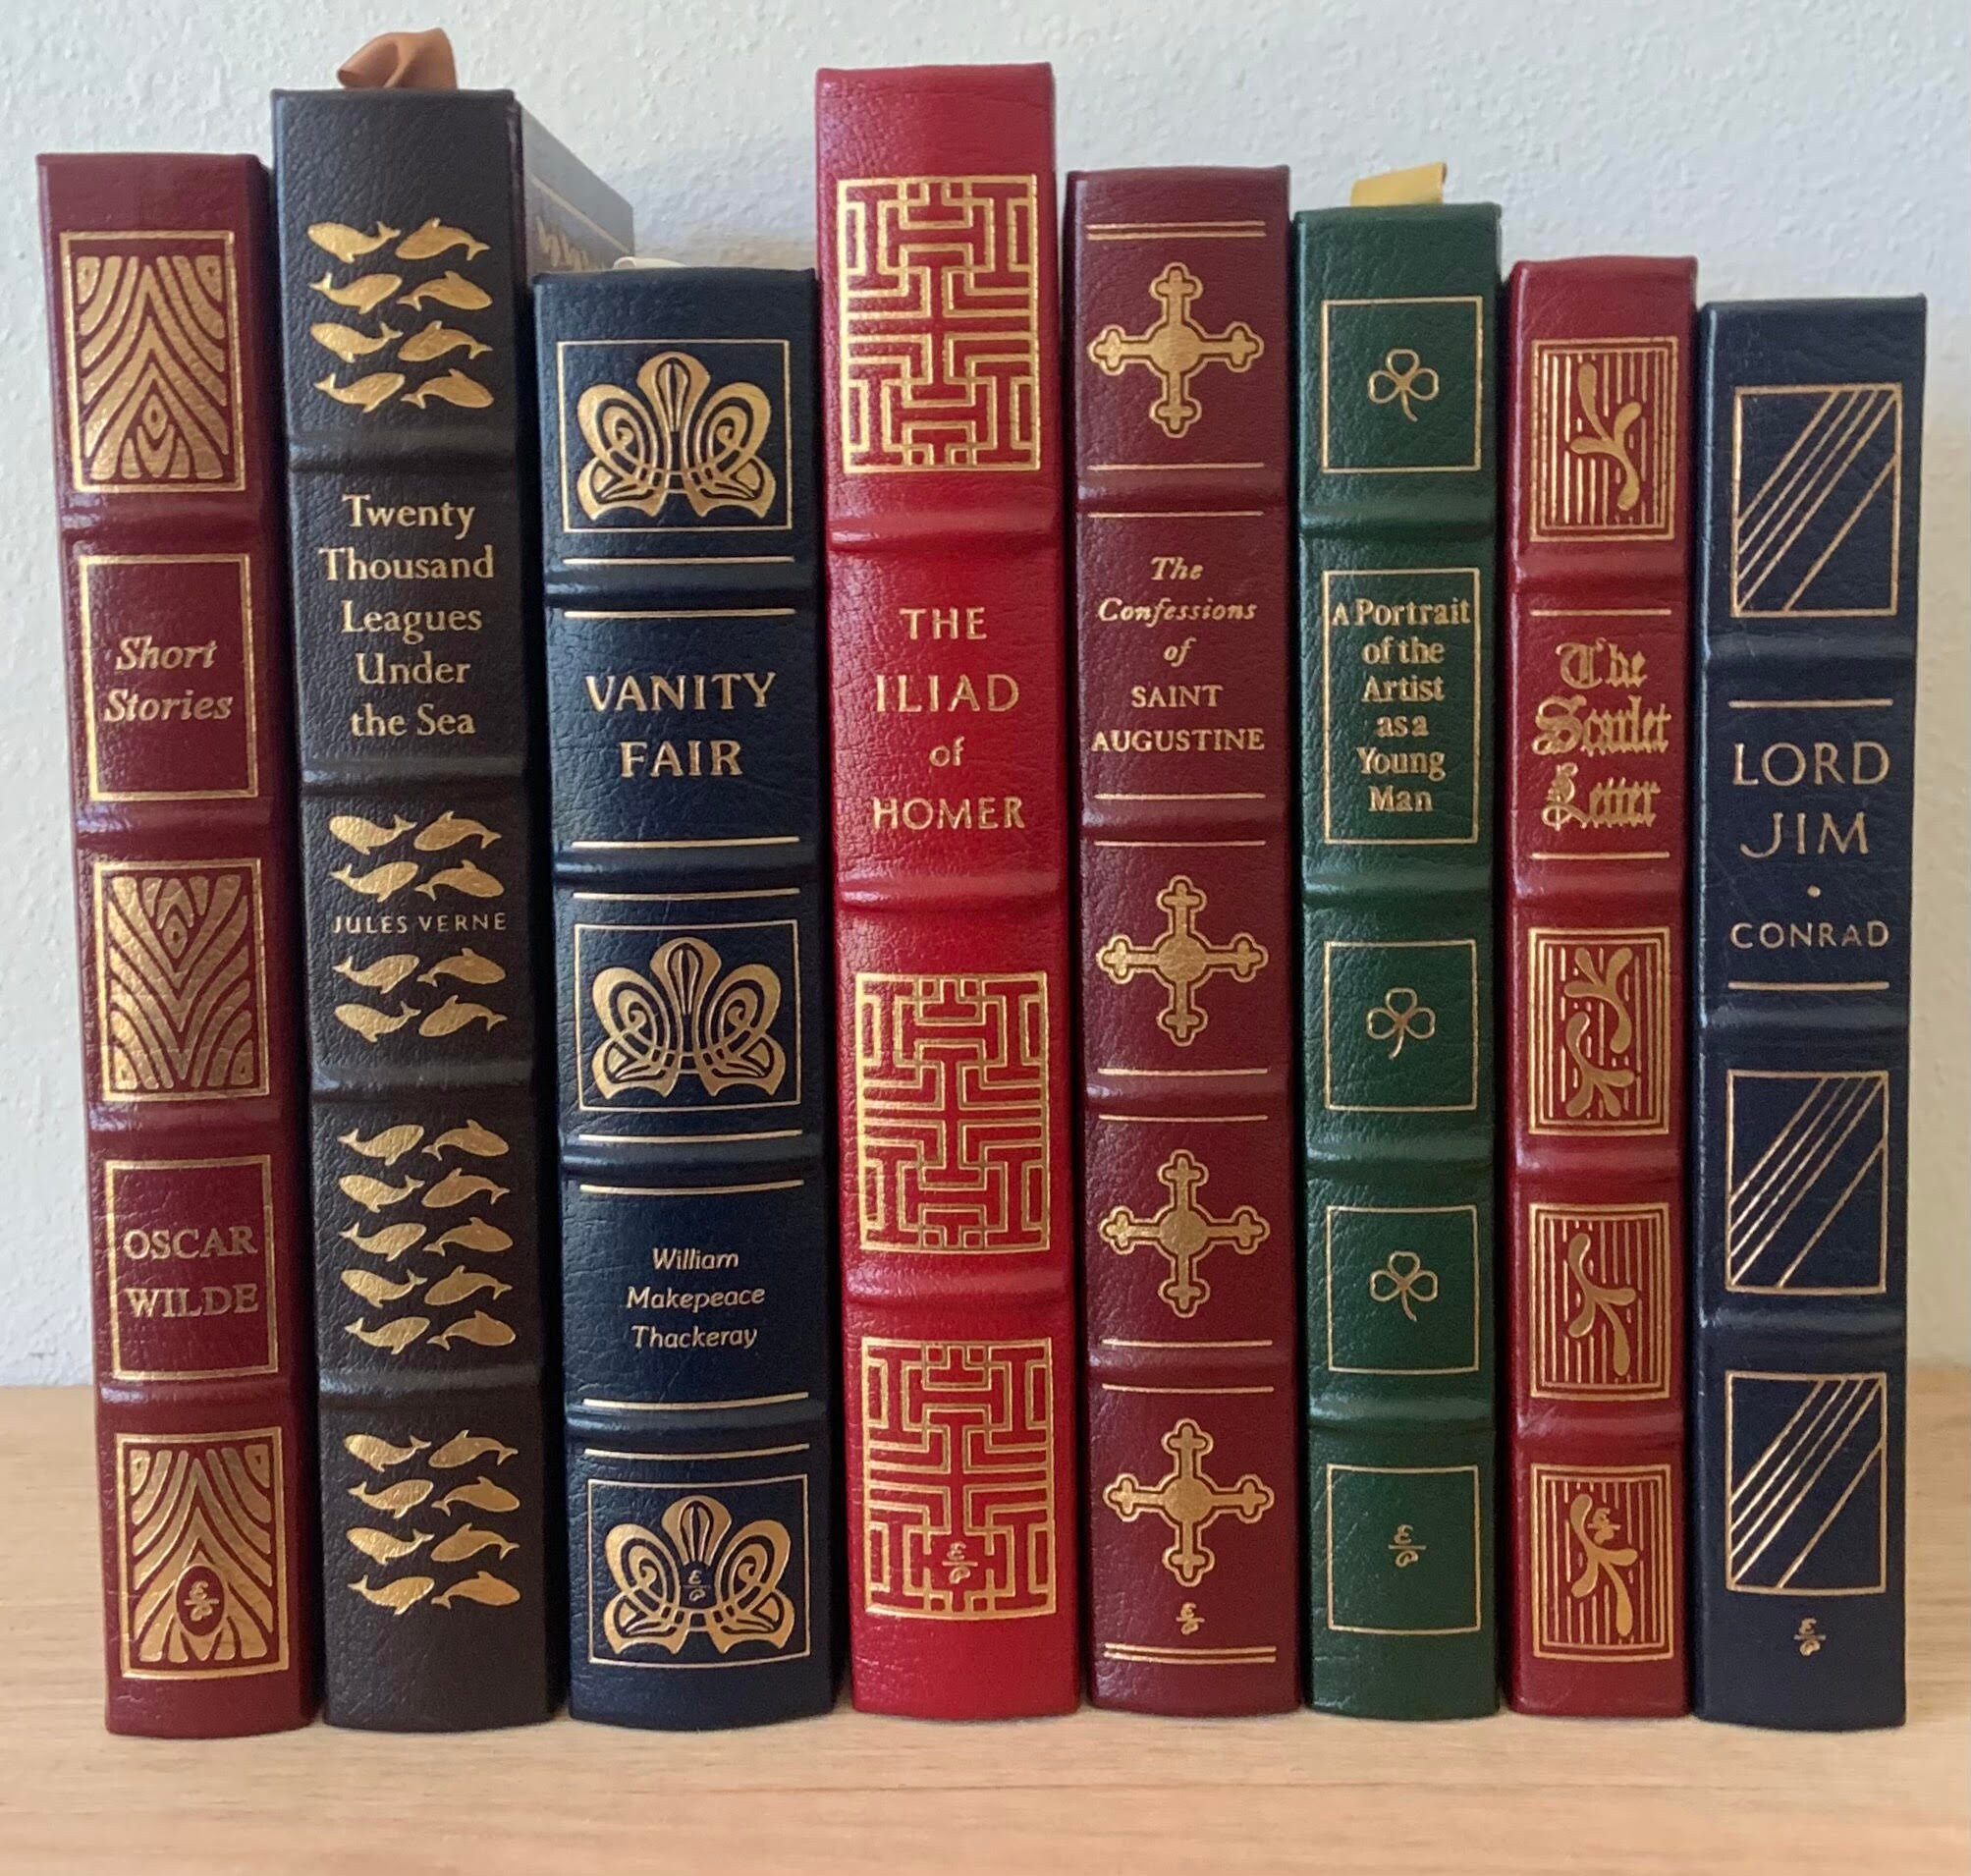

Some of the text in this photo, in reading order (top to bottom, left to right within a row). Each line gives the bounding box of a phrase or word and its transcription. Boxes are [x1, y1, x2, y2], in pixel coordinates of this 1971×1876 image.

[341, 493, 475, 539] Twenty
[319, 545, 494, 580] Thousand
[1150, 556, 1204, 580] The
[341, 598, 482, 644] Leagues
[900, 607, 987, 640] THE
[1097, 597, 1257, 628] Confessions
[1332, 598, 1471, 627] A Portrait
[116, 635, 217, 672] Short
[1164, 636, 1196, 667] of
[1361, 636, 1445, 665] of the
[1556, 636, 1648, 690] The
[356, 651, 470, 686] Under
[103, 687, 234, 723] Stories
[585, 672, 776, 712] VANITY
[876, 674, 1019, 712] ILIAD
[1131, 685, 1224, 708] SAINT
[1363, 675, 1445, 703] Artist
[351, 704, 476, 739] the Sea
[1376, 717, 1429, 738] as a
[1532, 694, 1671, 757] Scarlet
[929, 736, 964, 767] of
[1091, 729, 1265, 753] AUGUSTINE
[620, 740, 743, 778] FAIR
[1356, 747, 1446, 782] Young
[1732, 742, 1890, 787] LORD
[872, 796, 1024, 830] HOMER
[1368, 787, 1433, 812] Man
[1541, 762, 1661, 831] Letter
[1739, 811, 1868, 859] JIM
[333, 912, 507, 935] JULES VERNE
[1730, 920, 1889, 949] CONRAD
[123, 1225, 257, 1261] OSCAR
[652, 1247, 739, 1270] William
[126, 1285, 259, 1319] WILDE
[626, 1286, 765, 1313] Makepeace
[630, 1325, 758, 1349] Thackeray
